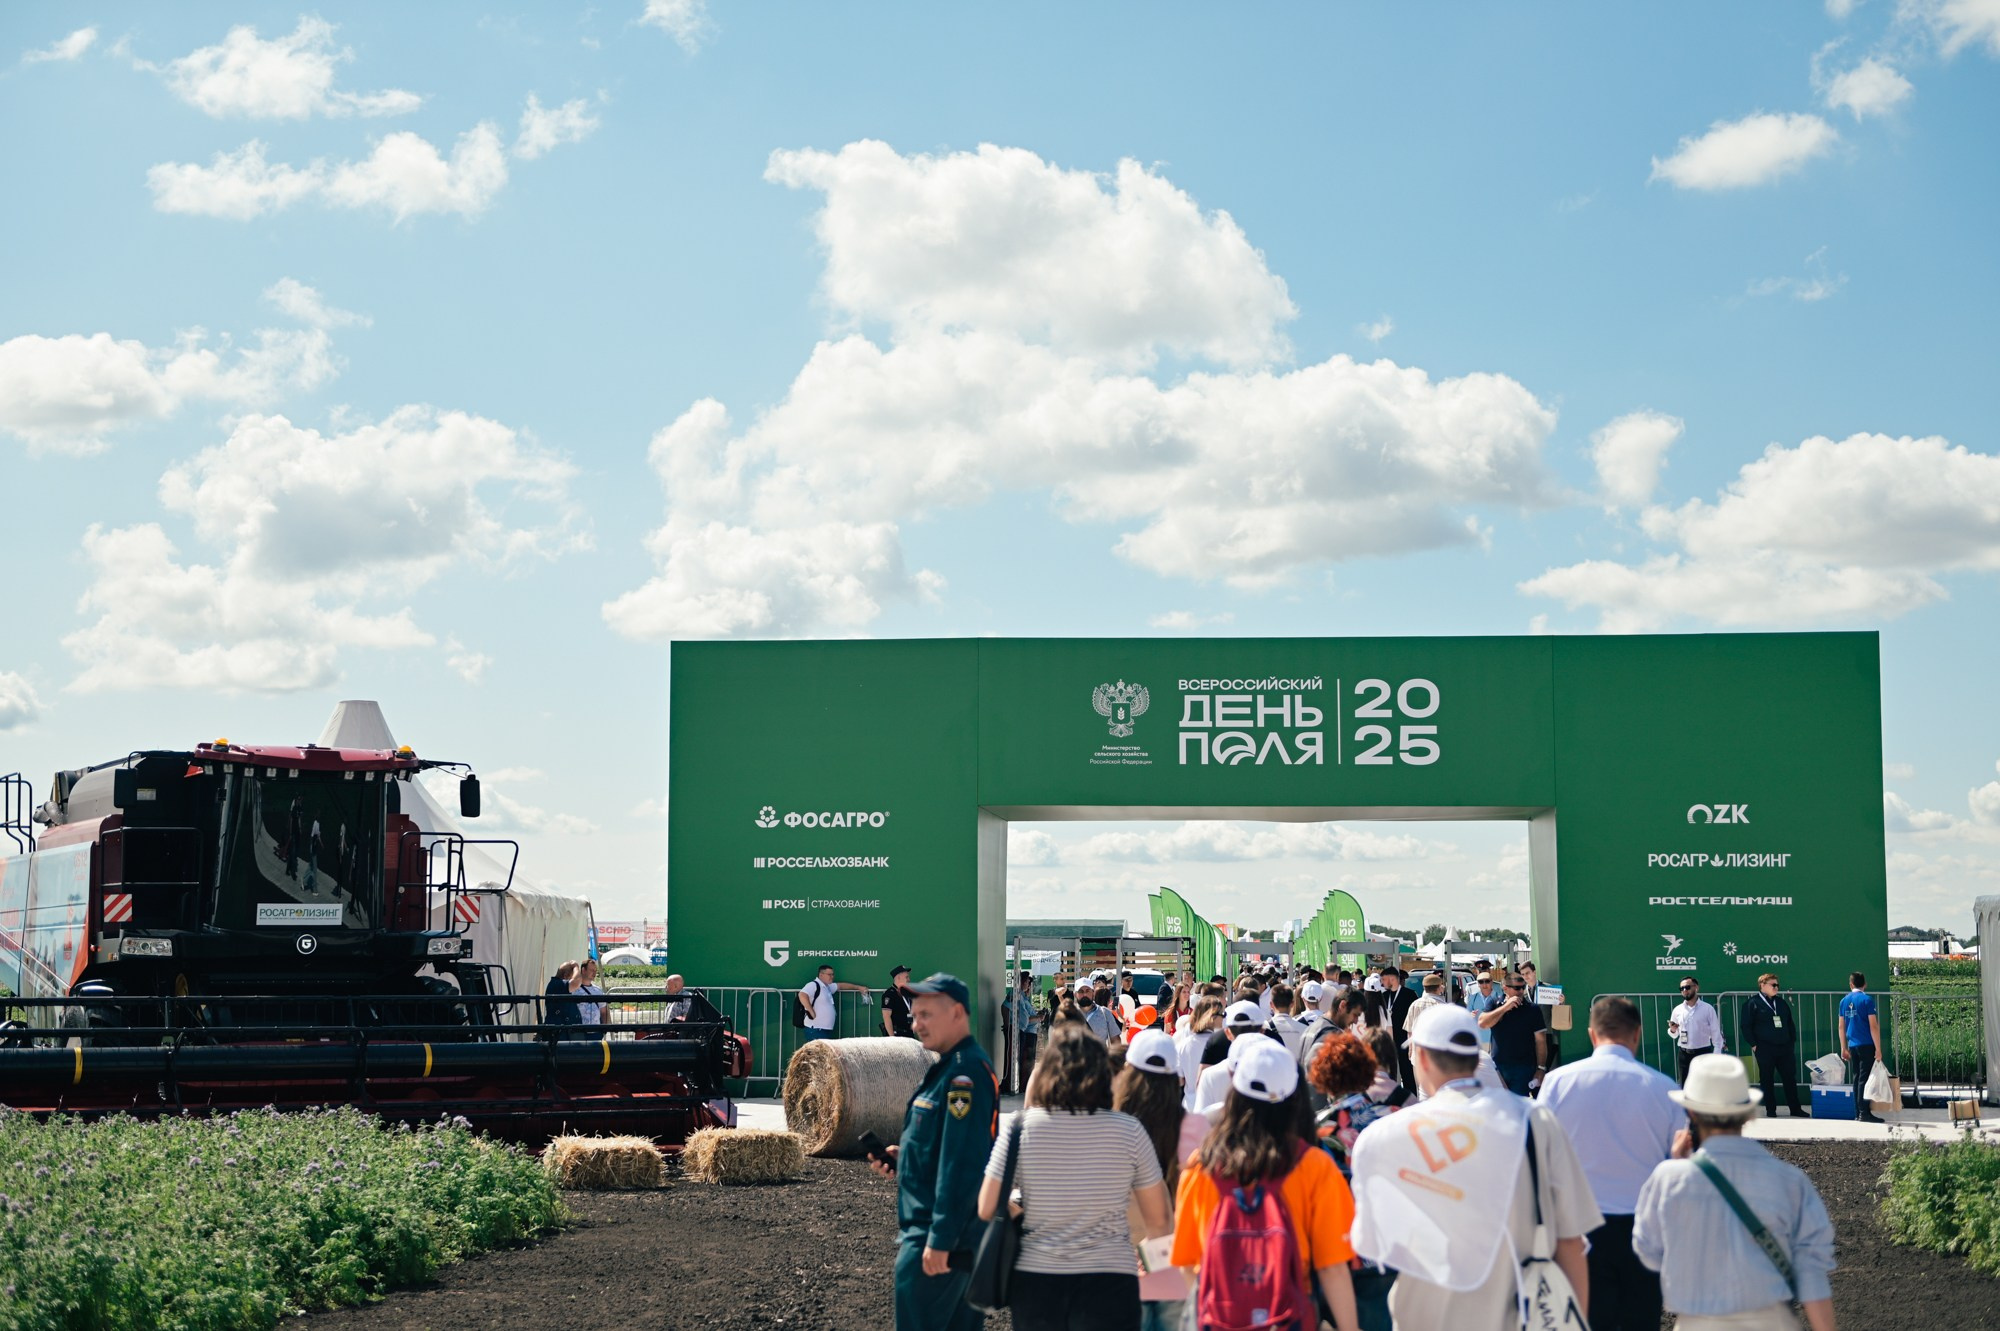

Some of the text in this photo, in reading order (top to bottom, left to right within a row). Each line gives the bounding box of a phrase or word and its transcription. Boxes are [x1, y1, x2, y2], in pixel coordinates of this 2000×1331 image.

[1178, 676, 1323, 690] ВСЕРОССИЙСКИЙ
[1354, 678, 1441, 719] 20
[1178, 694, 1324, 728] ДЕНЬ
[1178, 731, 1324, 766] ПОЛЯ
[1354, 725, 1441, 766] 25
[767, 856, 890, 868] РОССЕЛЬХОЗБАНК
[774, 899, 880, 909] РСХБ СТРАХОВАНИЕ
[1649, 896, 1793, 906] РОСТСЕЛЬМАШ
[1656, 956, 1697, 965] ПЕГАС
